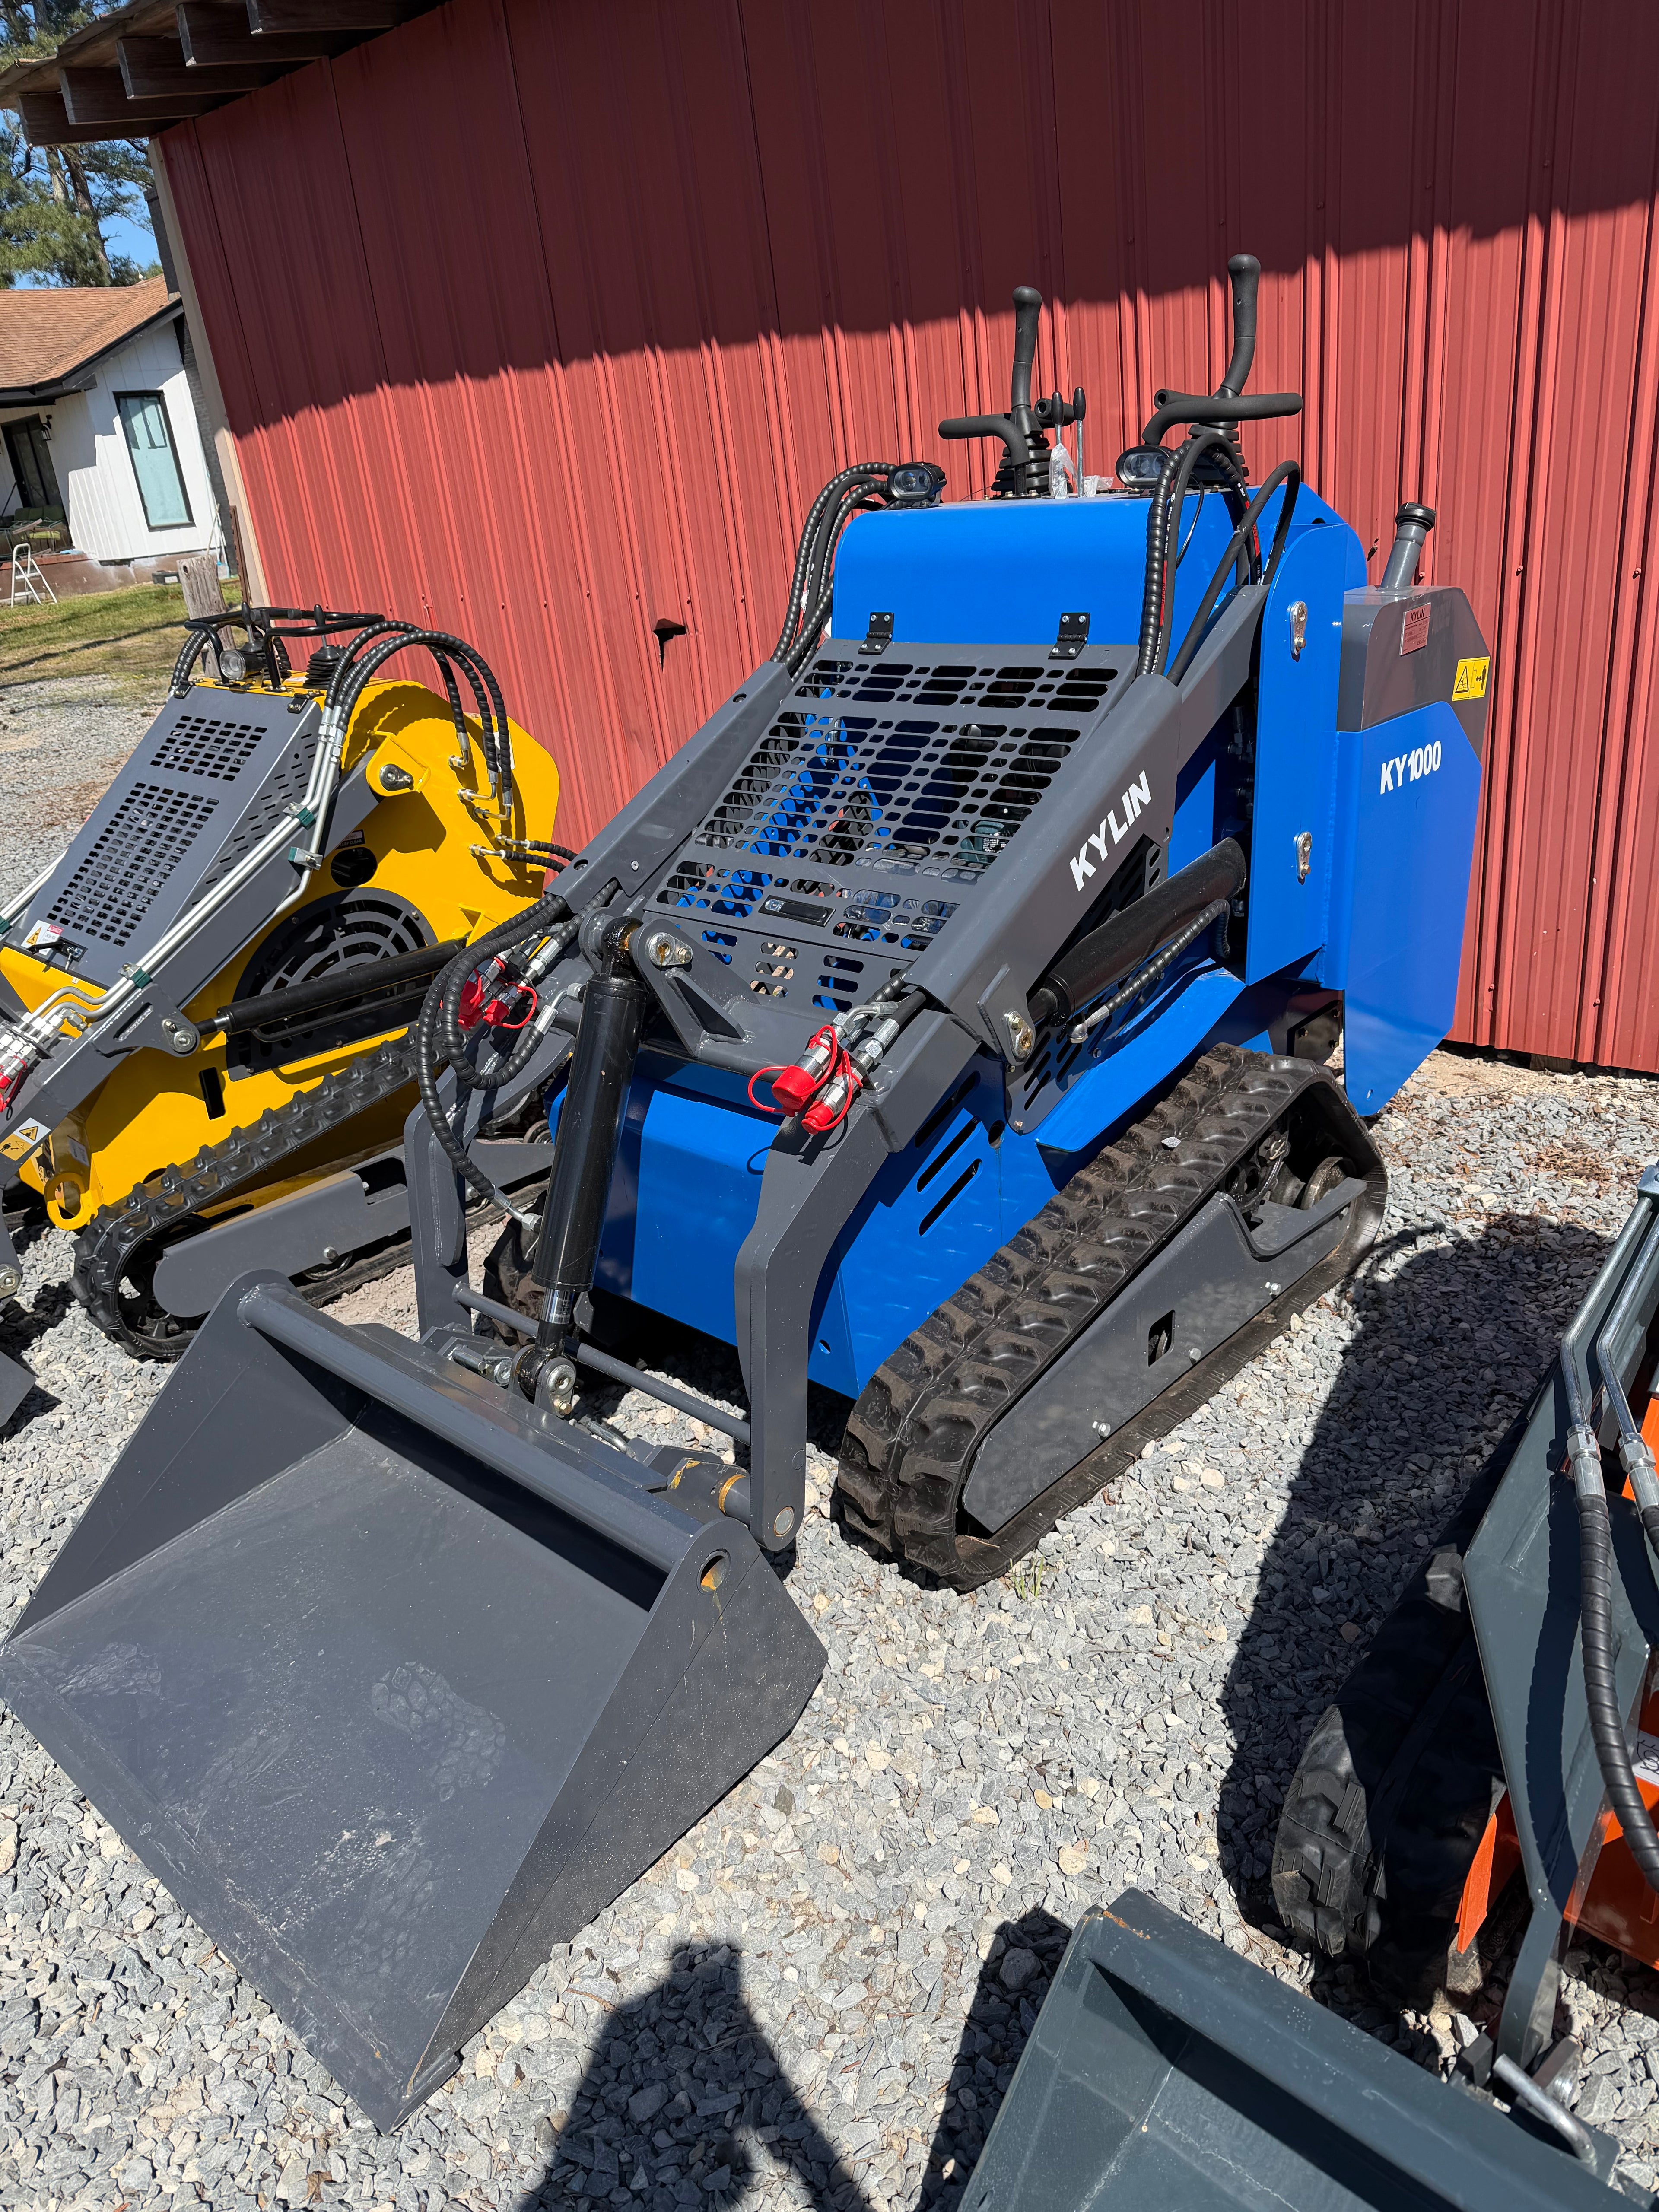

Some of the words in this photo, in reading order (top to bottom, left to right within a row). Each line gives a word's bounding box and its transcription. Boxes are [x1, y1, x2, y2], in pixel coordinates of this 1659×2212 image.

[1410, 608, 1425, 622] KYLIN
[1380, 740, 1442, 795] KY1000
[1069, 770, 1151, 892] KYLIN
